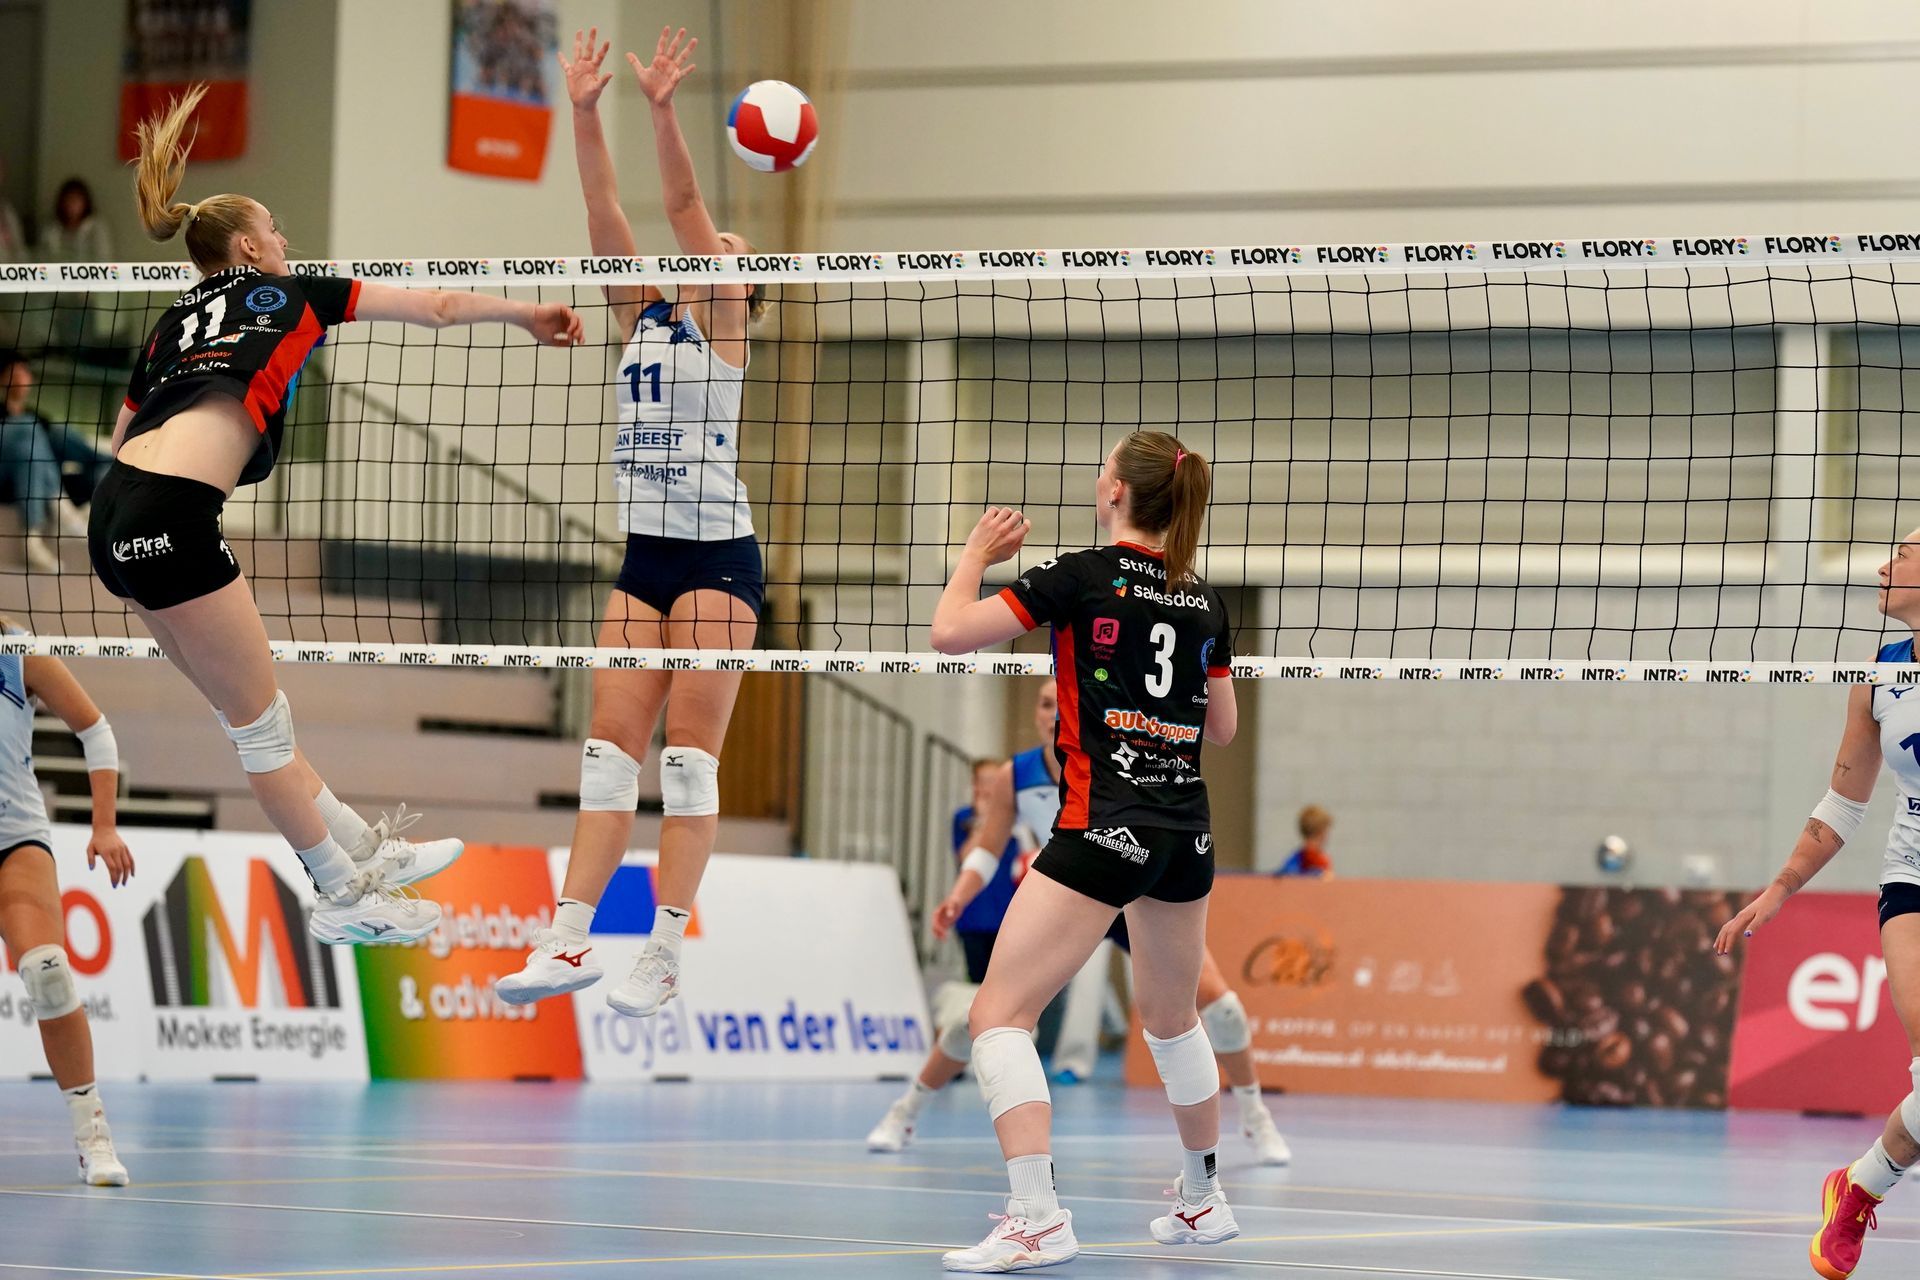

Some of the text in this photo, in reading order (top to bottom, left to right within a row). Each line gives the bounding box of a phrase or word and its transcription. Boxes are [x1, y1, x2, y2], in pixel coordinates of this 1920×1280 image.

[178, 294, 226, 352] 11
[622, 362, 662, 402] 11
[633, 433, 683, 446] BEEST
[132, 532, 171, 554] Firat
[1134, 584, 1210, 611] salesdock
[1144, 622, 1176, 698] 3
[1084, 831, 1150, 858] HYPOTHEEKADVIES
[1130, 853, 1147, 865] MAAT
[401, 976, 424, 1018] &
[157, 1016, 346, 1057] Moker Energie
[698, 1011, 768, 1051] van
[778, 1000, 837, 1051] der
[845, 1000, 925, 1053] leun
